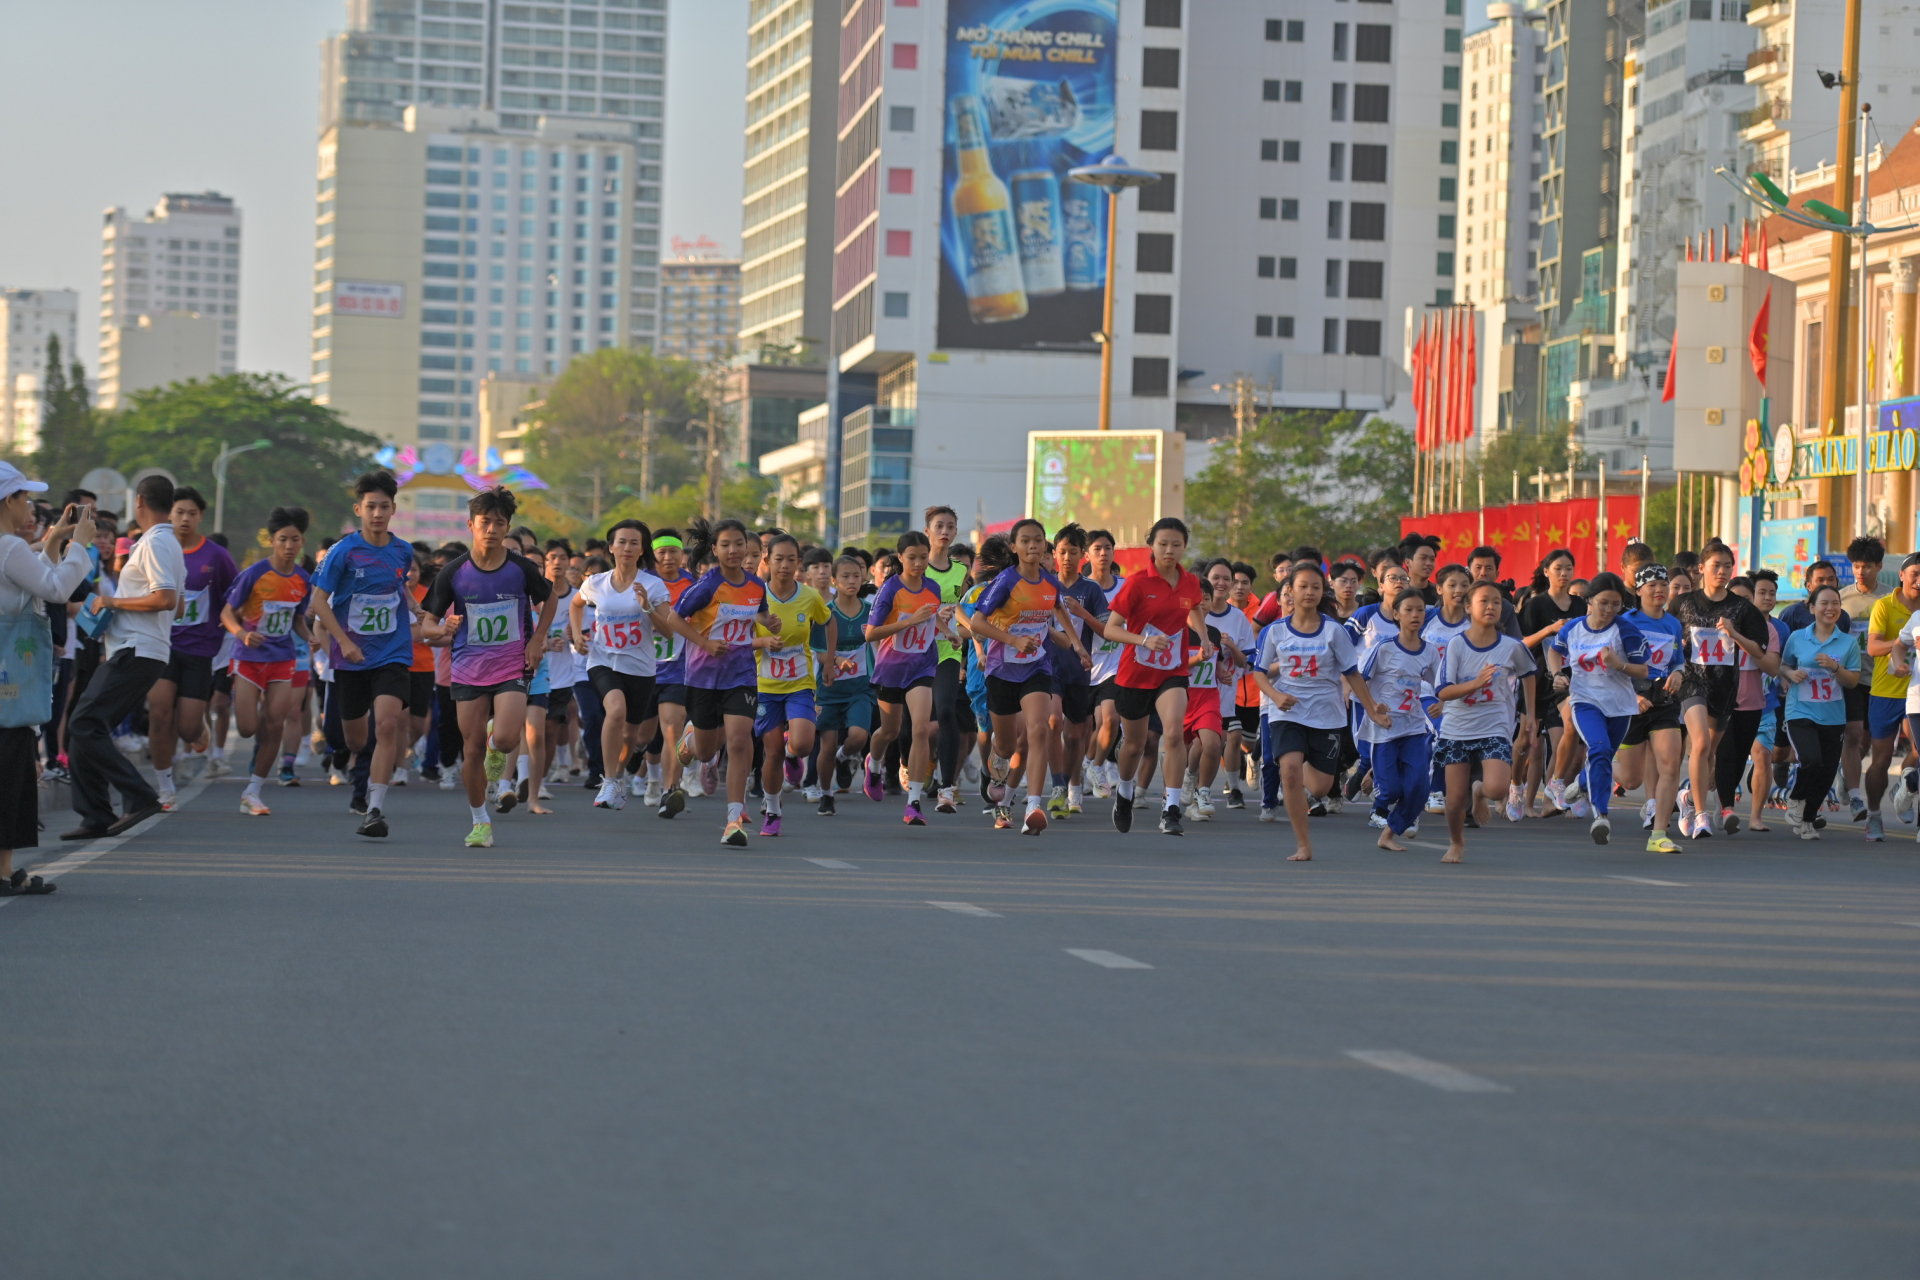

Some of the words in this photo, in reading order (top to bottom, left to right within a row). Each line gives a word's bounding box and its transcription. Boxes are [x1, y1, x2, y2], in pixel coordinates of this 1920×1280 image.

[1055, 31, 1105, 47] CHILL
[1046, 48, 1096, 63] CHILL
[1811, 418, 1858, 477] KÍNH
[360, 607, 391, 631] 20
[477, 615, 508, 643] 02
[606, 613, 641, 622] Sacombank
[602, 621, 642, 649] 155
[903, 626, 926, 650] 04
[1145, 640, 1175, 667] 18
[1290, 644, 1326, 652] Sacombank
[1699, 639, 1725, 662] 44
[771, 657, 797, 678] 01
[1193, 662, 1213, 685] 72
[1288, 655, 1318, 678] 24
[1809, 678, 1832, 700] 15
